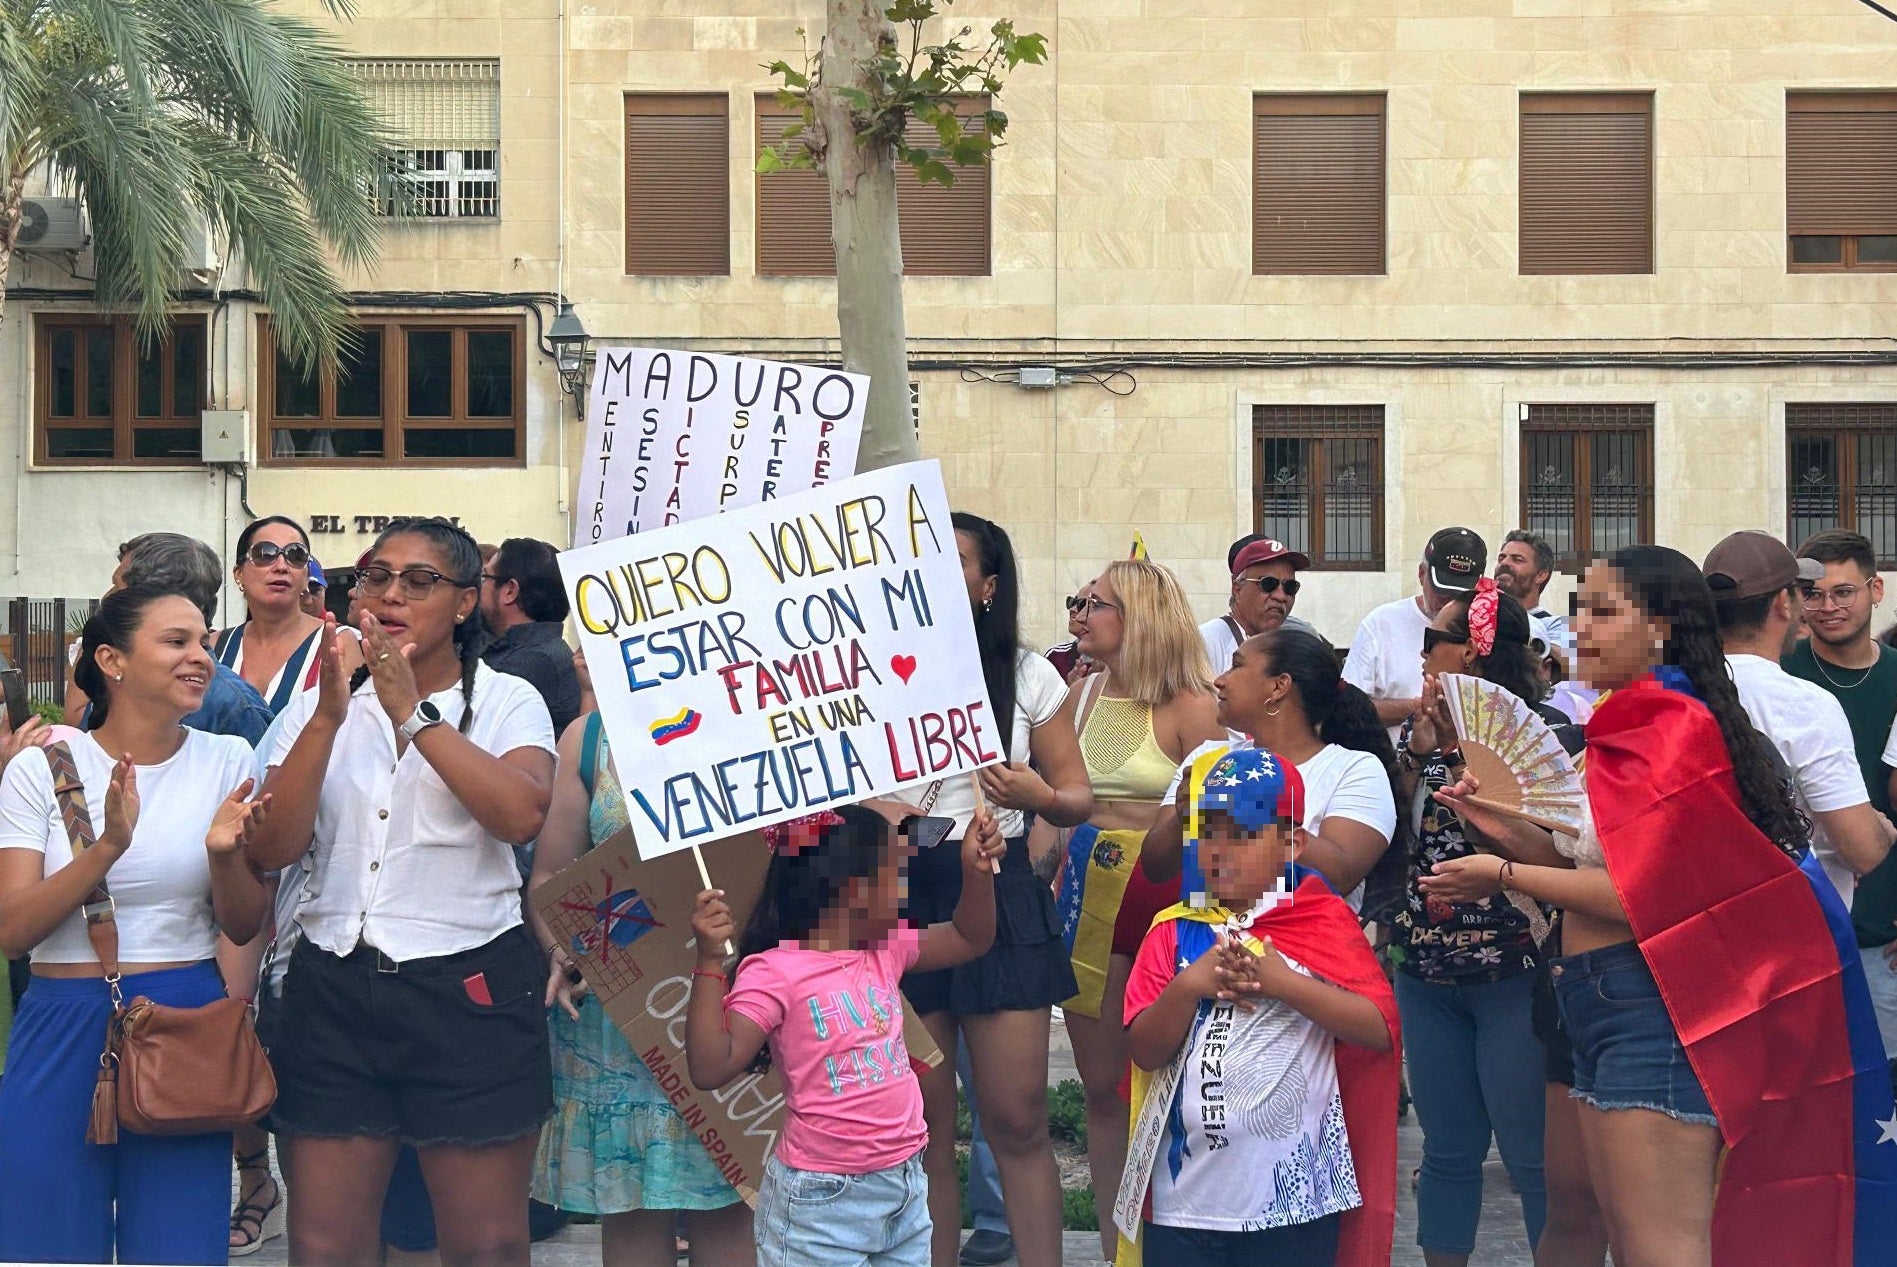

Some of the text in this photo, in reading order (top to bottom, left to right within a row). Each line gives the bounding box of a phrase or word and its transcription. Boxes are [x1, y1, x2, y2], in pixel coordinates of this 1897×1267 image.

[602, 352, 854, 420] MADURO
[310, 515, 345, 533] EL
[575, 484, 942, 638] QUIERO VOLVER A
[619, 569, 934, 692] ESTAR CON MI
[717, 638, 882, 714] FAMILIA
[768, 694, 876, 743] EN UNA
[630, 701, 998, 842] VENEZUELA LIBRE
[642, 1045, 748, 1187] MADE IN SPAIN
